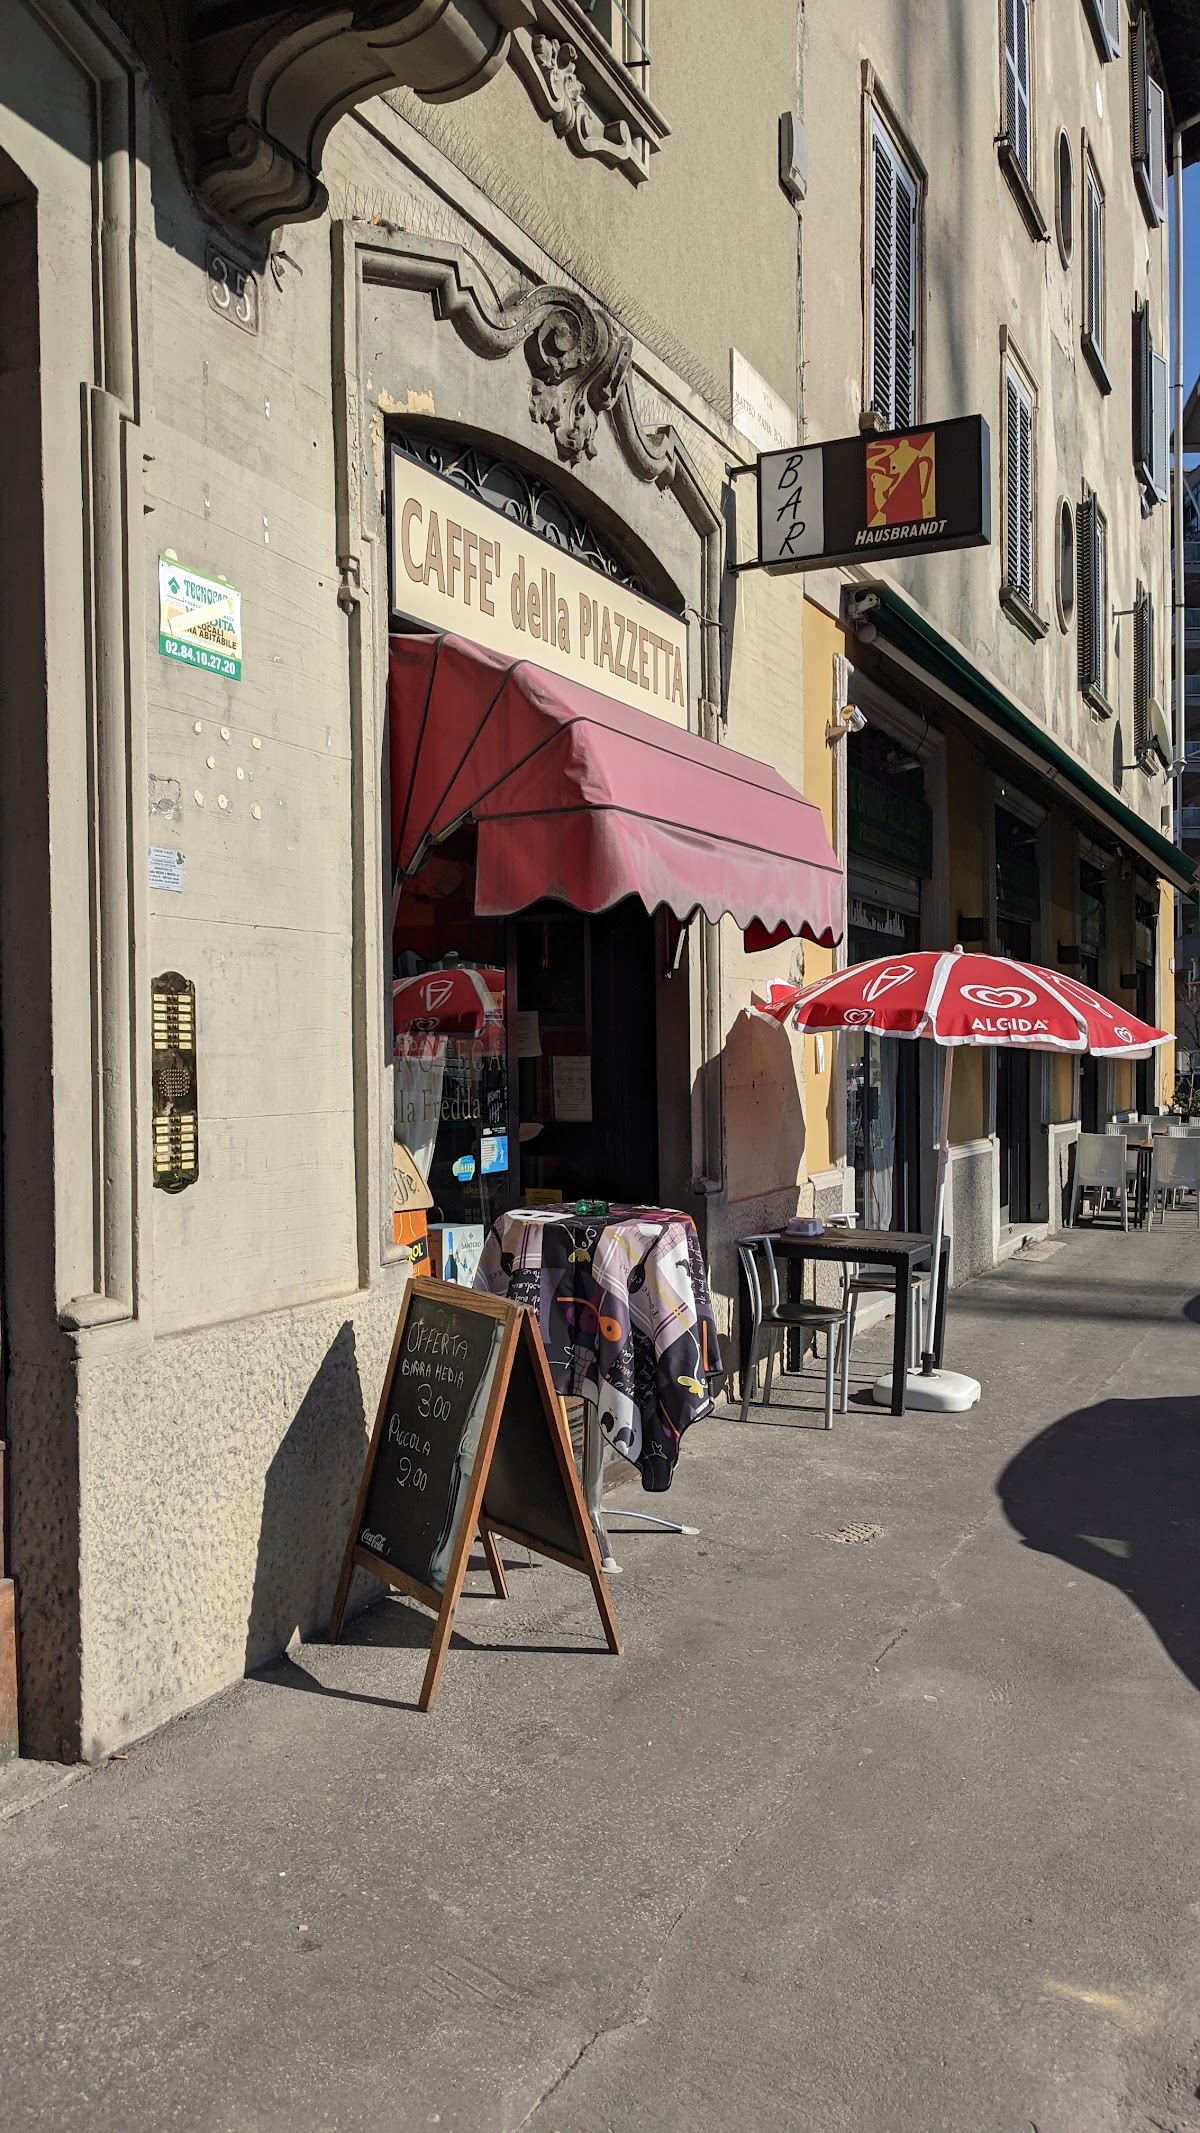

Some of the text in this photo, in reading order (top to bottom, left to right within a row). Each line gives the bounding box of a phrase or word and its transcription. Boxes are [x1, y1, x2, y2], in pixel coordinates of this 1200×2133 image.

[211, 256, 251, 323] 35
[777, 454, 806, 556] BAR
[855, 519, 948, 546] HAUSBRANDT
[401, 497, 685, 707] CAFFE' della PIAZZETTA
[165, 639, 236, 675] 02.84.10.27.20
[199, 629, 237, 650] ABITABILE
[396, 1039, 503, 1073] NOTECA
[421, 1086, 481, 1122] Fredda
[461, 1240, 482, 1250] SANTERO
[407, 1321, 468, 1360] OFFERTA
[402, 1358, 431, 1378] BIRRA
[417, 1383, 451, 1421] 3.00
[388, 1413, 431, 1456] PICCOLA
